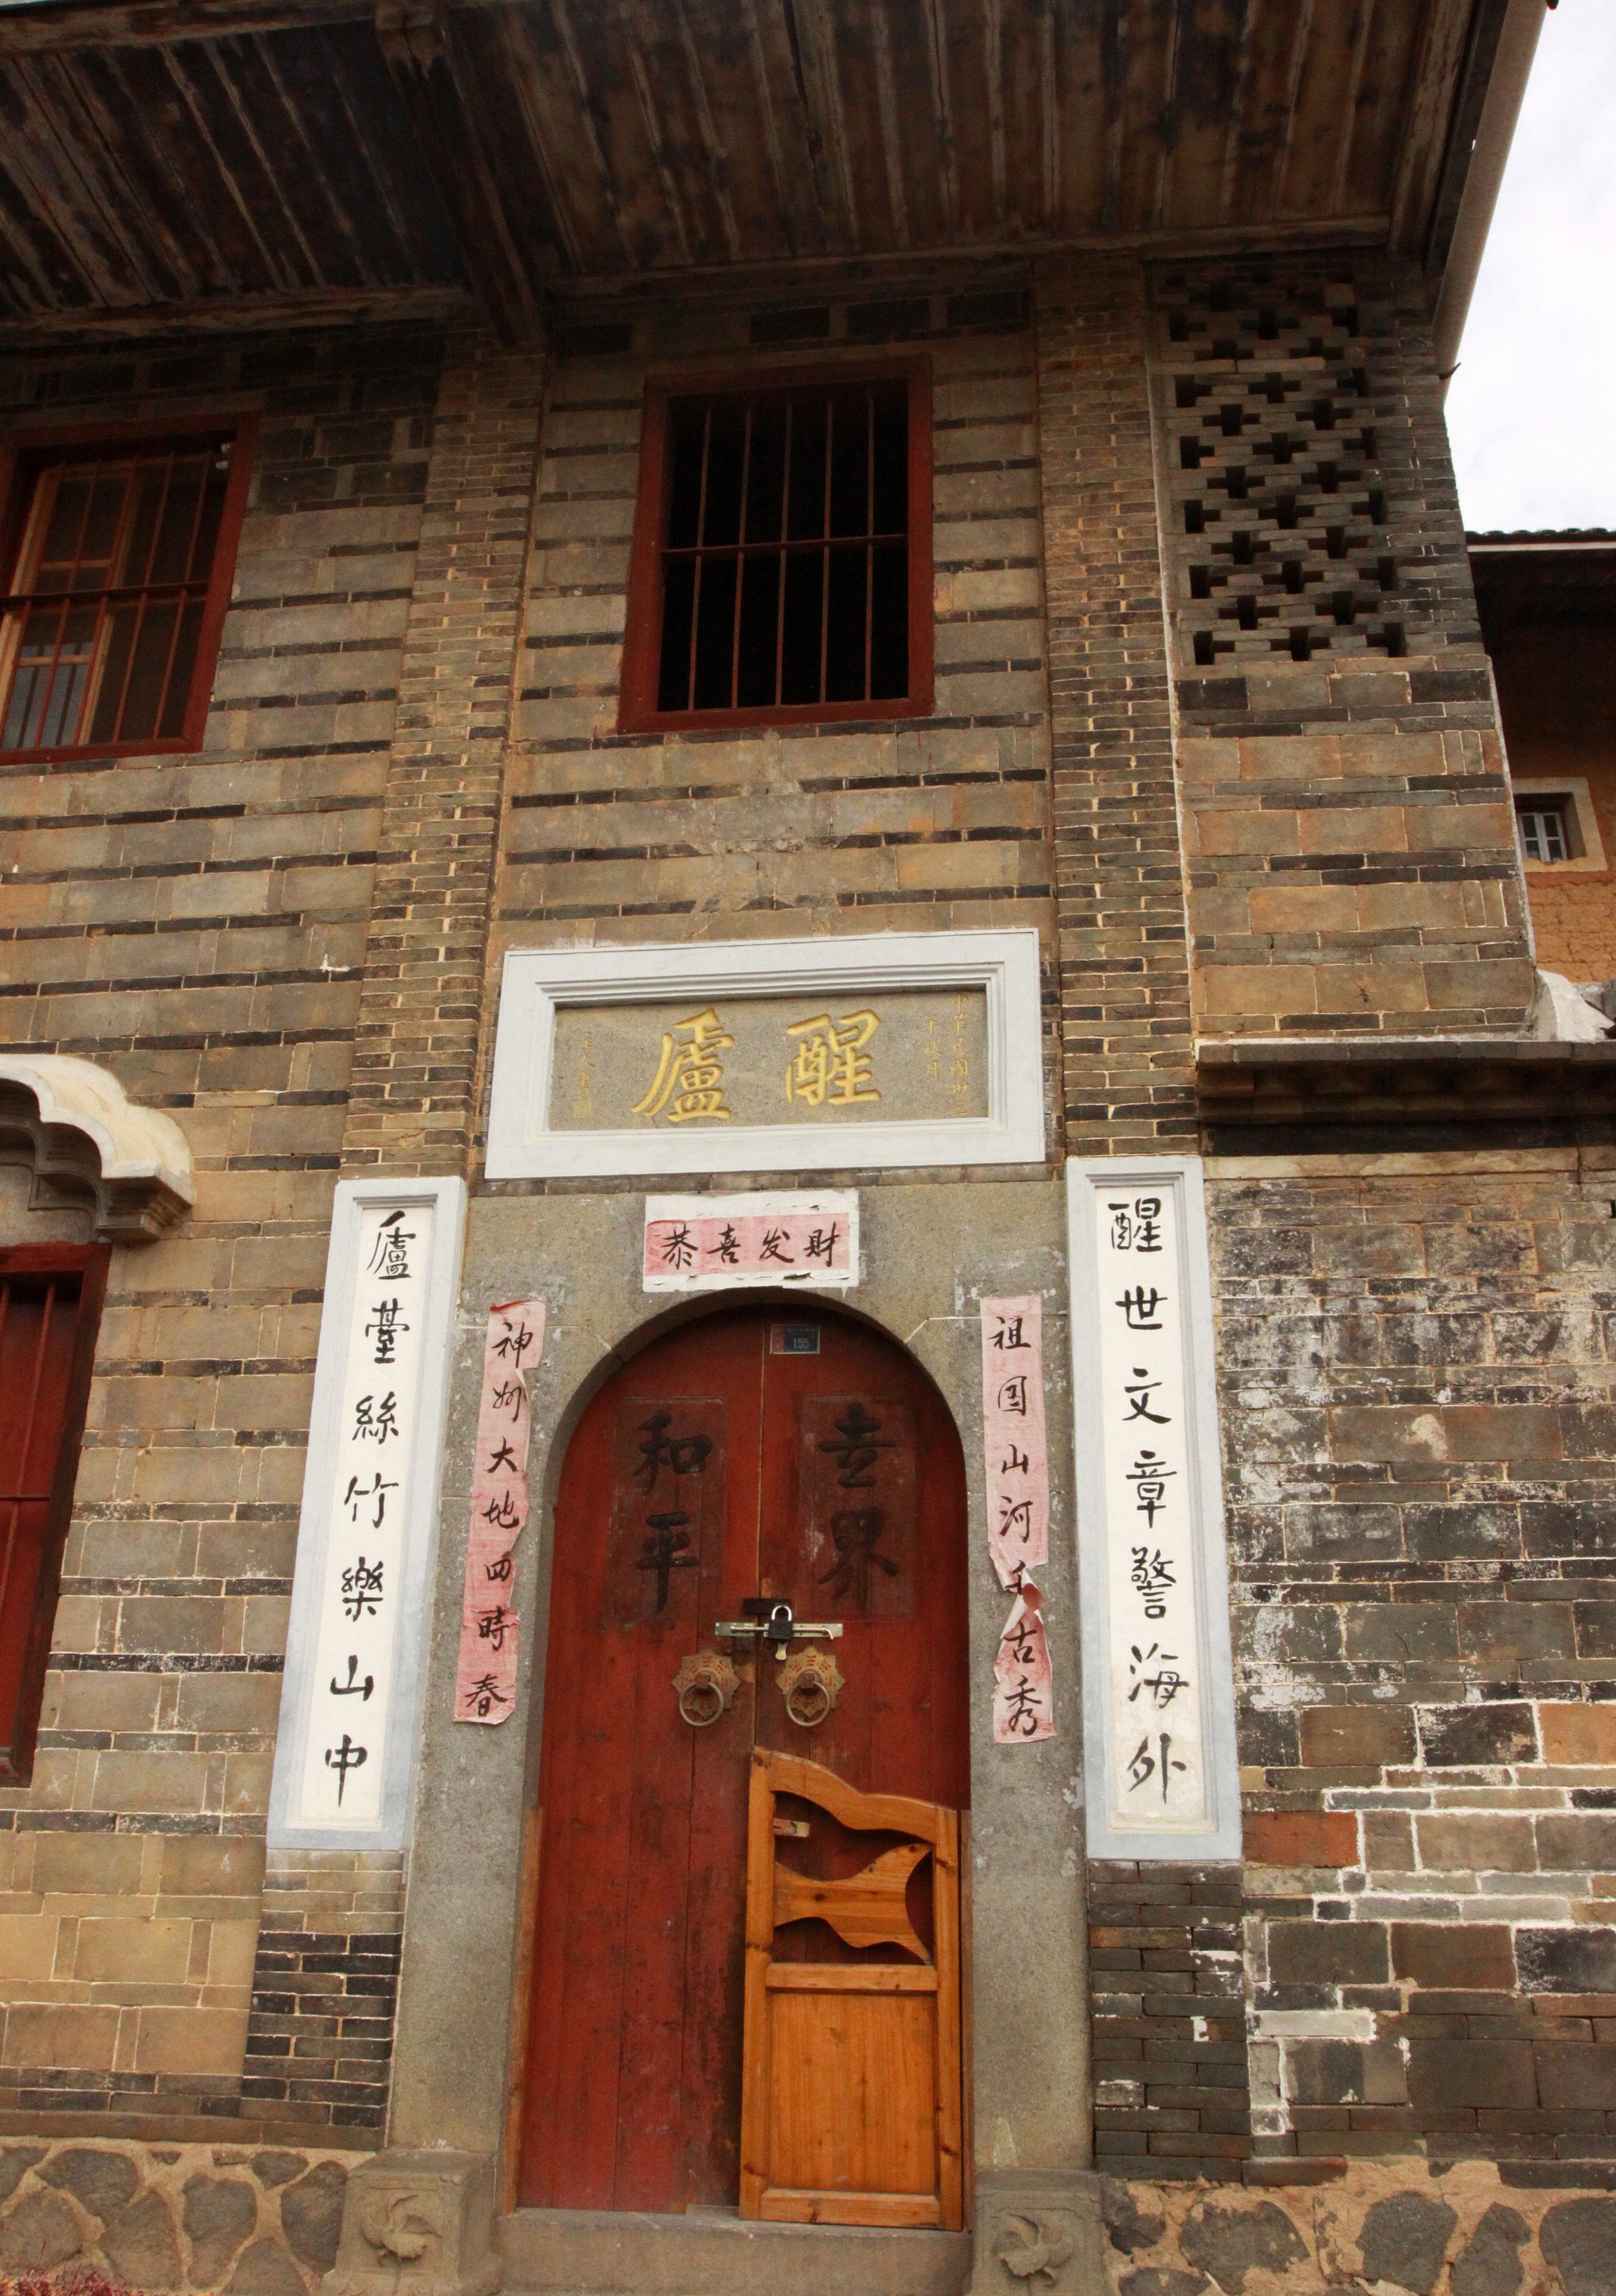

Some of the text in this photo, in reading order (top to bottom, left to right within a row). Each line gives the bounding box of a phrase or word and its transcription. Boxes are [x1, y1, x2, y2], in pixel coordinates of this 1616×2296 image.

[793, 1338, 809, 1349] 155
[632, 1409, 713, 1612] 和平
[1107, 1197, 1189, 1804] 醒世文章警海外
